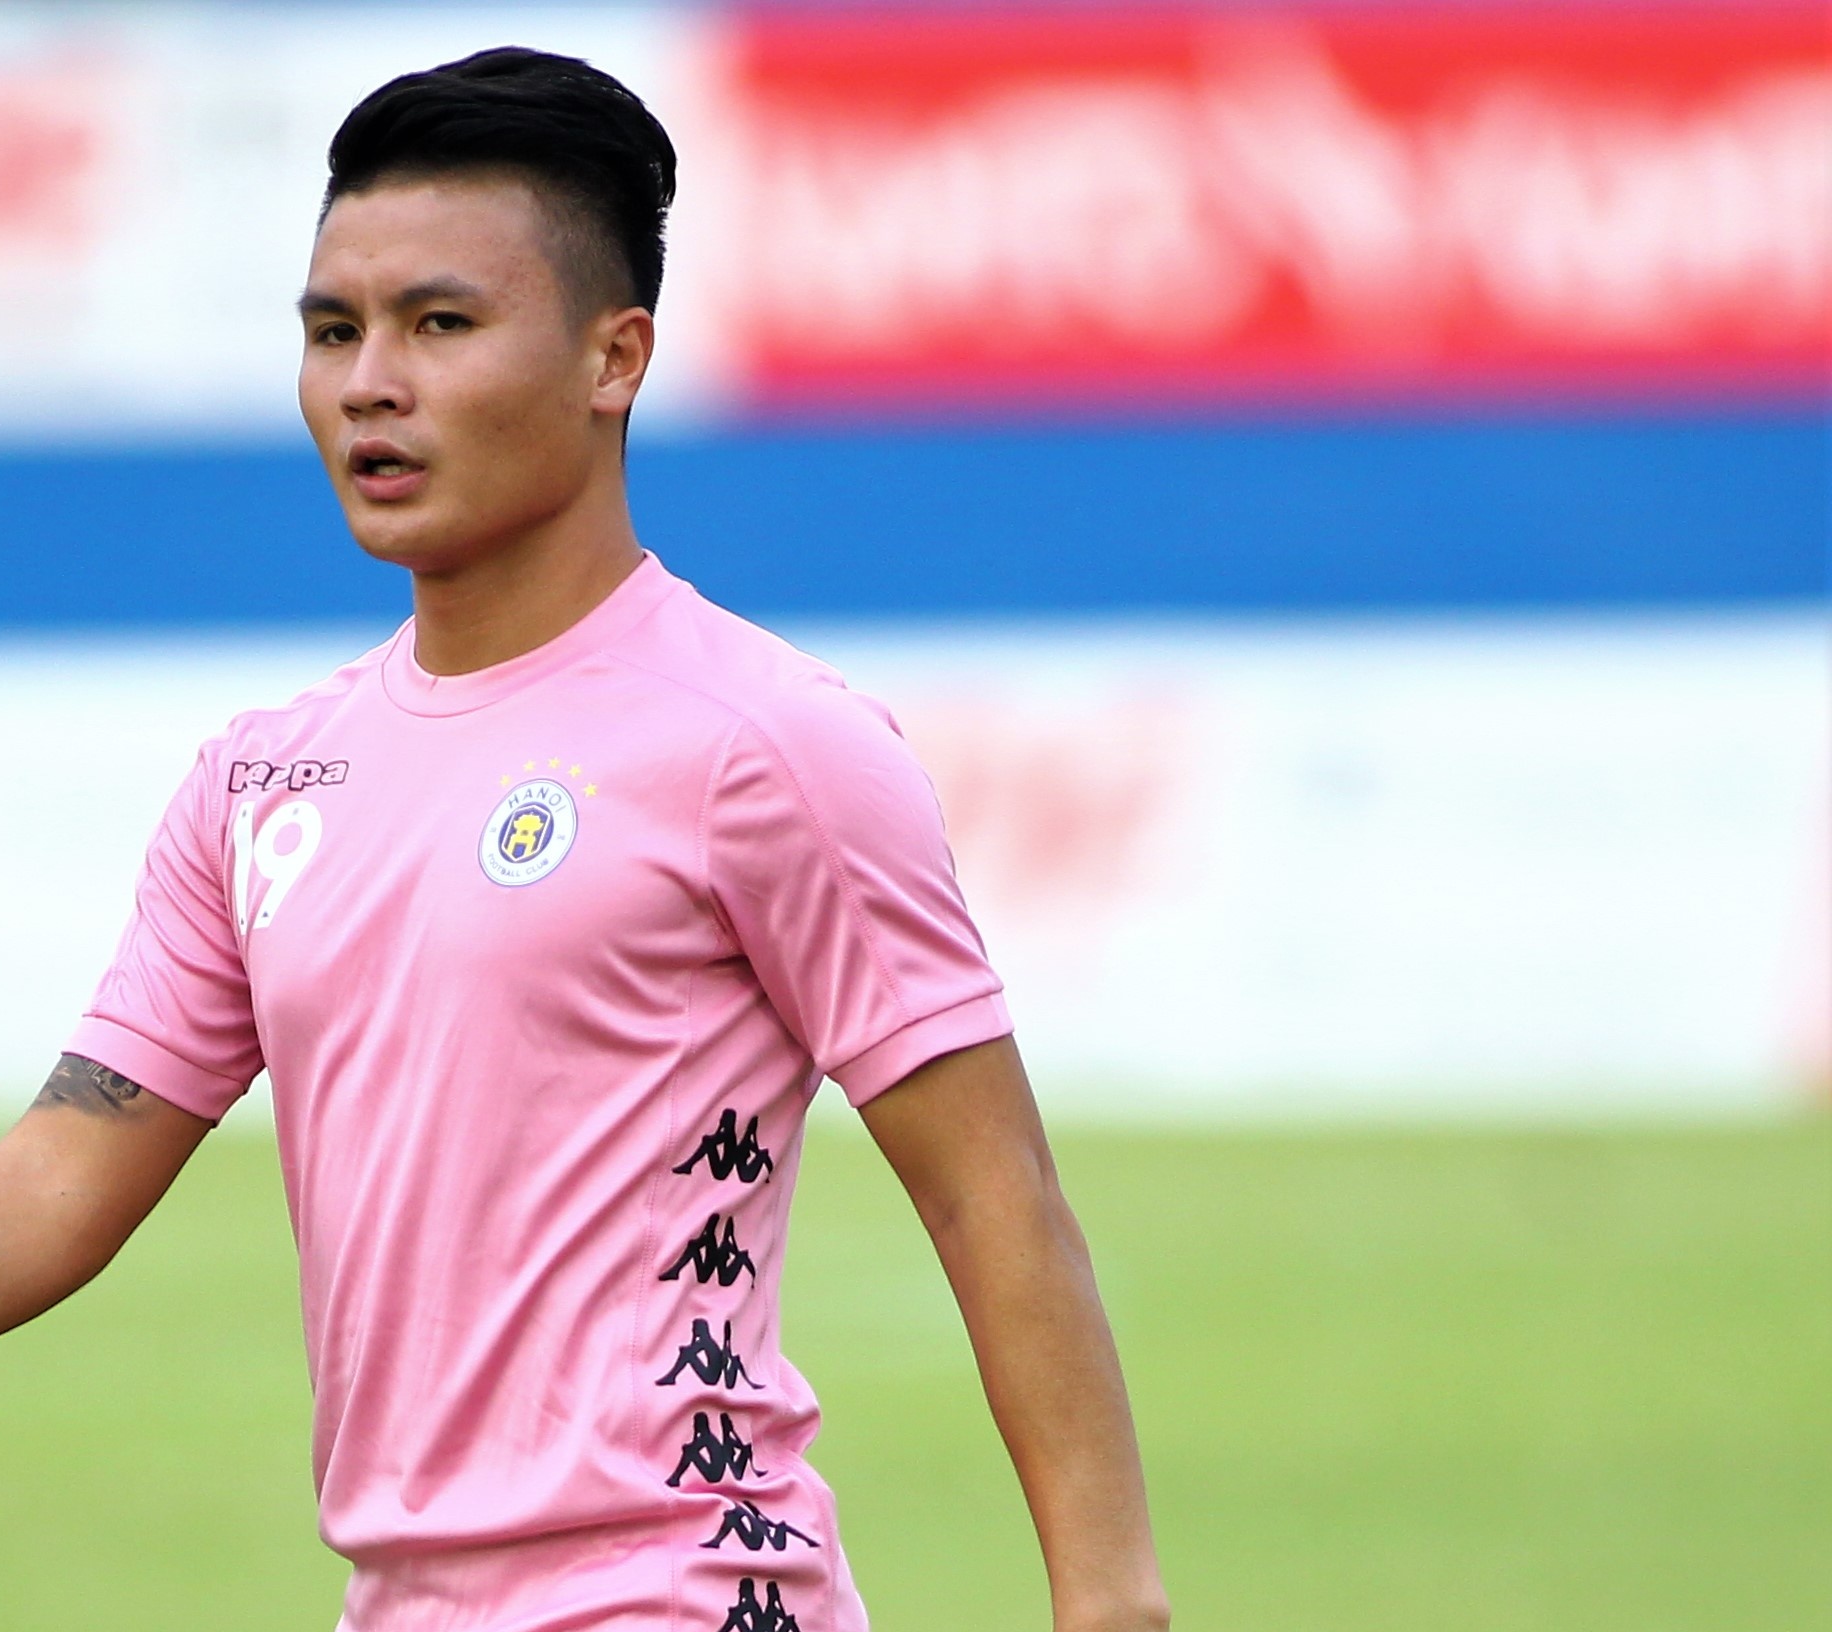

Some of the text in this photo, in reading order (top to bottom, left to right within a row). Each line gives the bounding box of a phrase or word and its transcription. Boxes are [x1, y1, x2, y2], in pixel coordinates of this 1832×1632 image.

[507, 786, 567, 813] HANOI
[233, 800, 323, 936] 19
[488, 853, 520, 877] FOOTBALL
